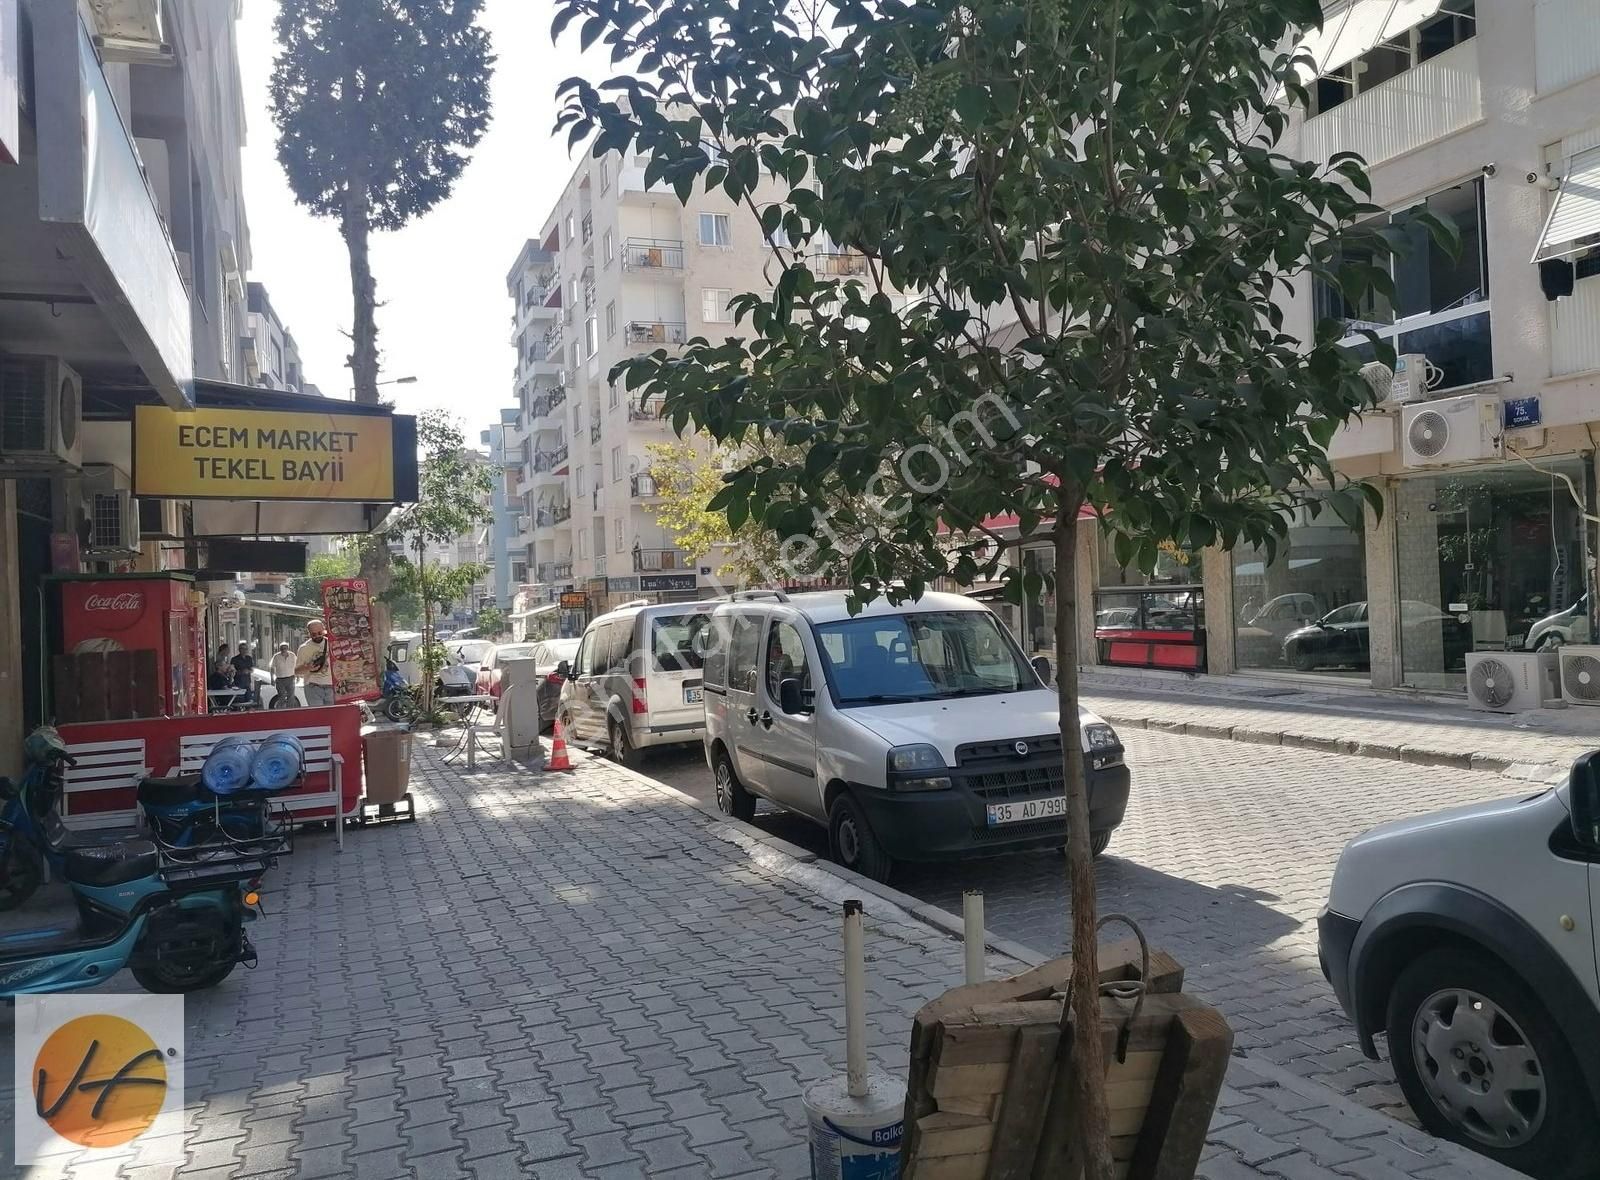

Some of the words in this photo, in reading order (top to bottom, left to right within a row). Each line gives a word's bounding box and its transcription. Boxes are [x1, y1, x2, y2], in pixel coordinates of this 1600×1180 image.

[179, 425, 249, 449] ECEM
[257, 429, 358, 452] MARKET
[194, 457, 275, 480] TEKEL
[84, 593, 142, 611] Coca-Cola
[997, 805, 1012, 821] 35
[1022, 802, 1036, 818] AD
